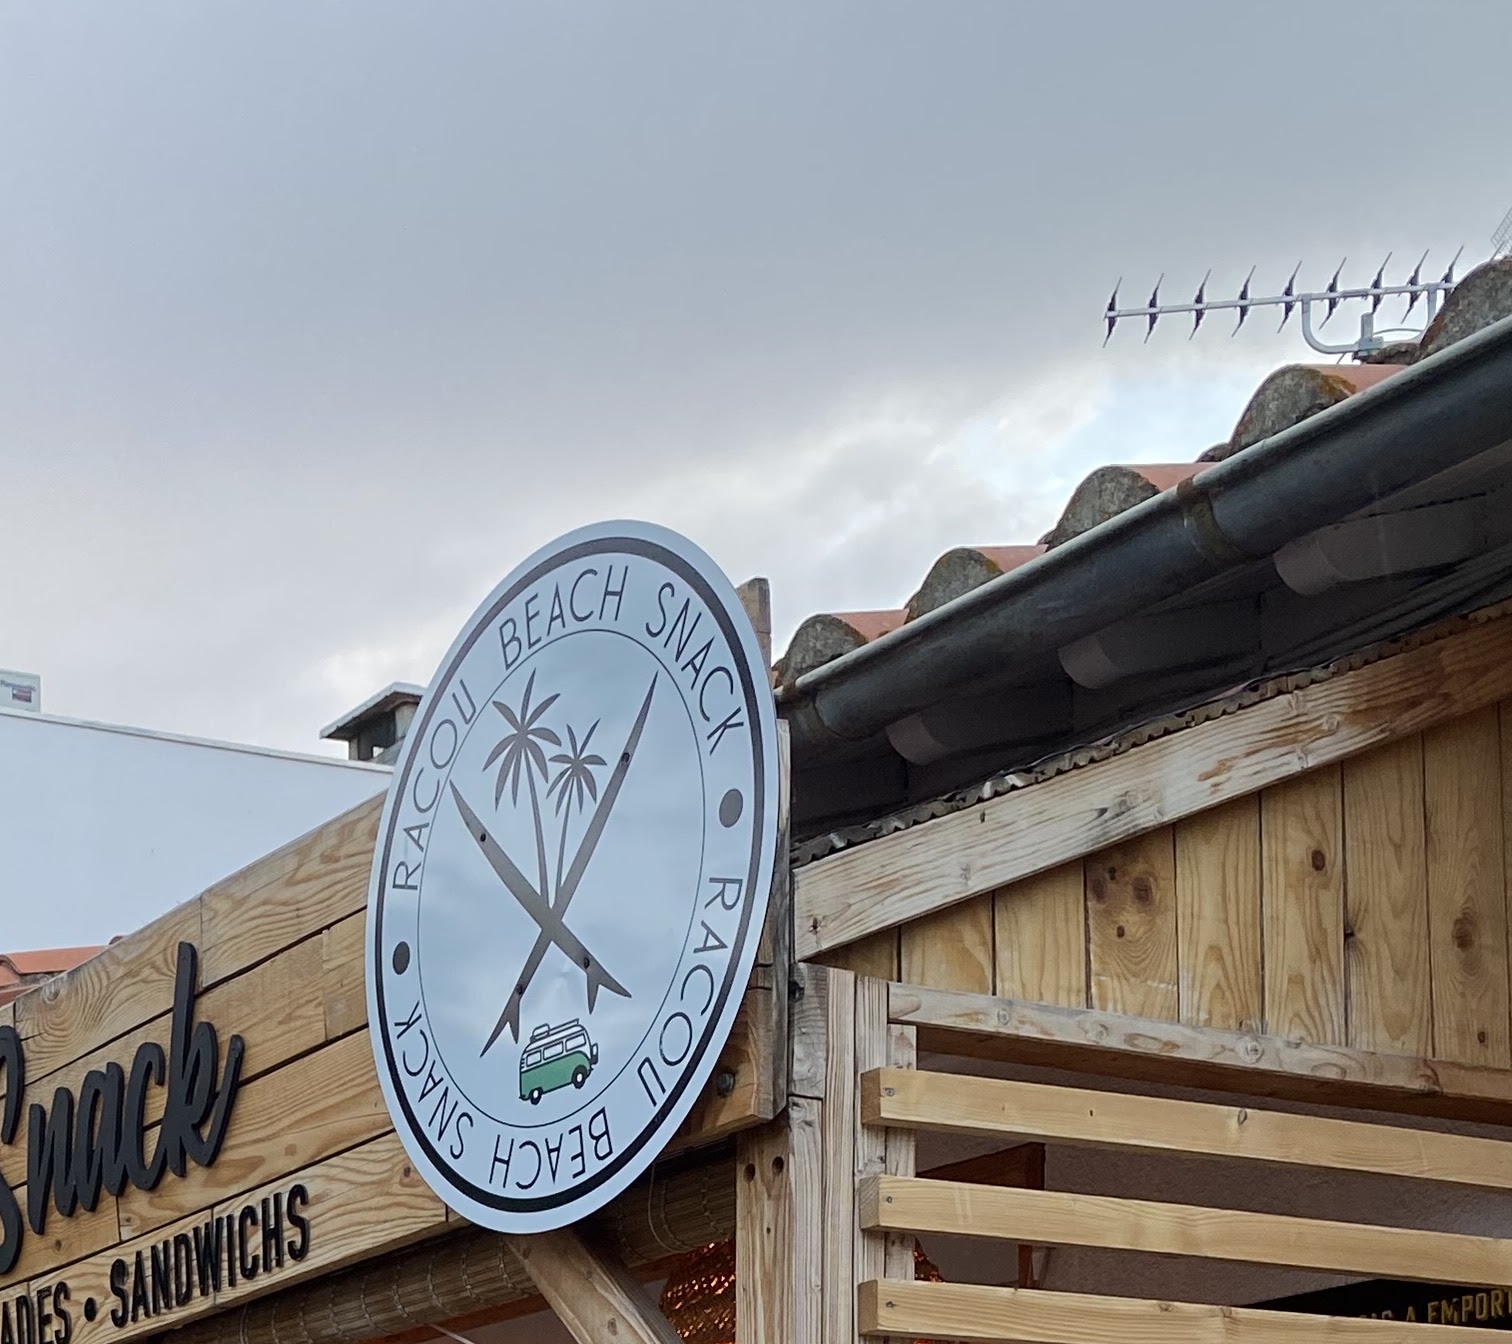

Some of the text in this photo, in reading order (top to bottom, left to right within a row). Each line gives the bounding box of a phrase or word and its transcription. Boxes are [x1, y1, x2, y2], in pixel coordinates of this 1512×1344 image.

[391, 562, 747, 892] RACOU BEACH SNACK
[395, 875, 744, 1190] RACOU BEACH SNACK
[109, 1184, 312, 1329] SANDWICHS
[1427, 1288, 1512, 1325] EMPORT
